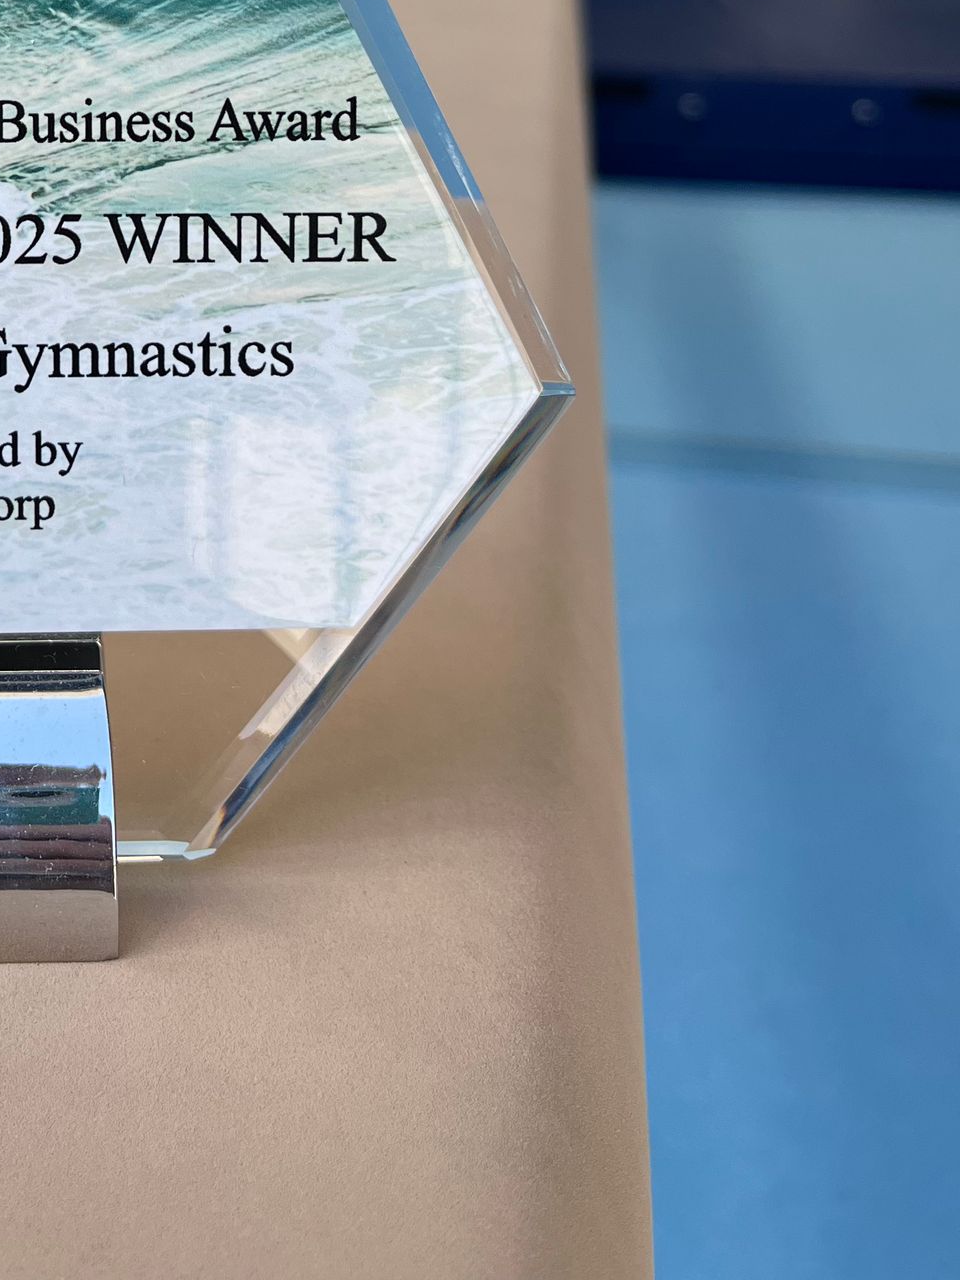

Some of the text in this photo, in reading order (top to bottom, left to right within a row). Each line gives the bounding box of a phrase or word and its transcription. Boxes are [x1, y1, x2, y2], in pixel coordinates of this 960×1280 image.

[206, 96, 361, 142] Award
[102, 212, 397, 264] WINNER
[32, 430, 83, 477] by
